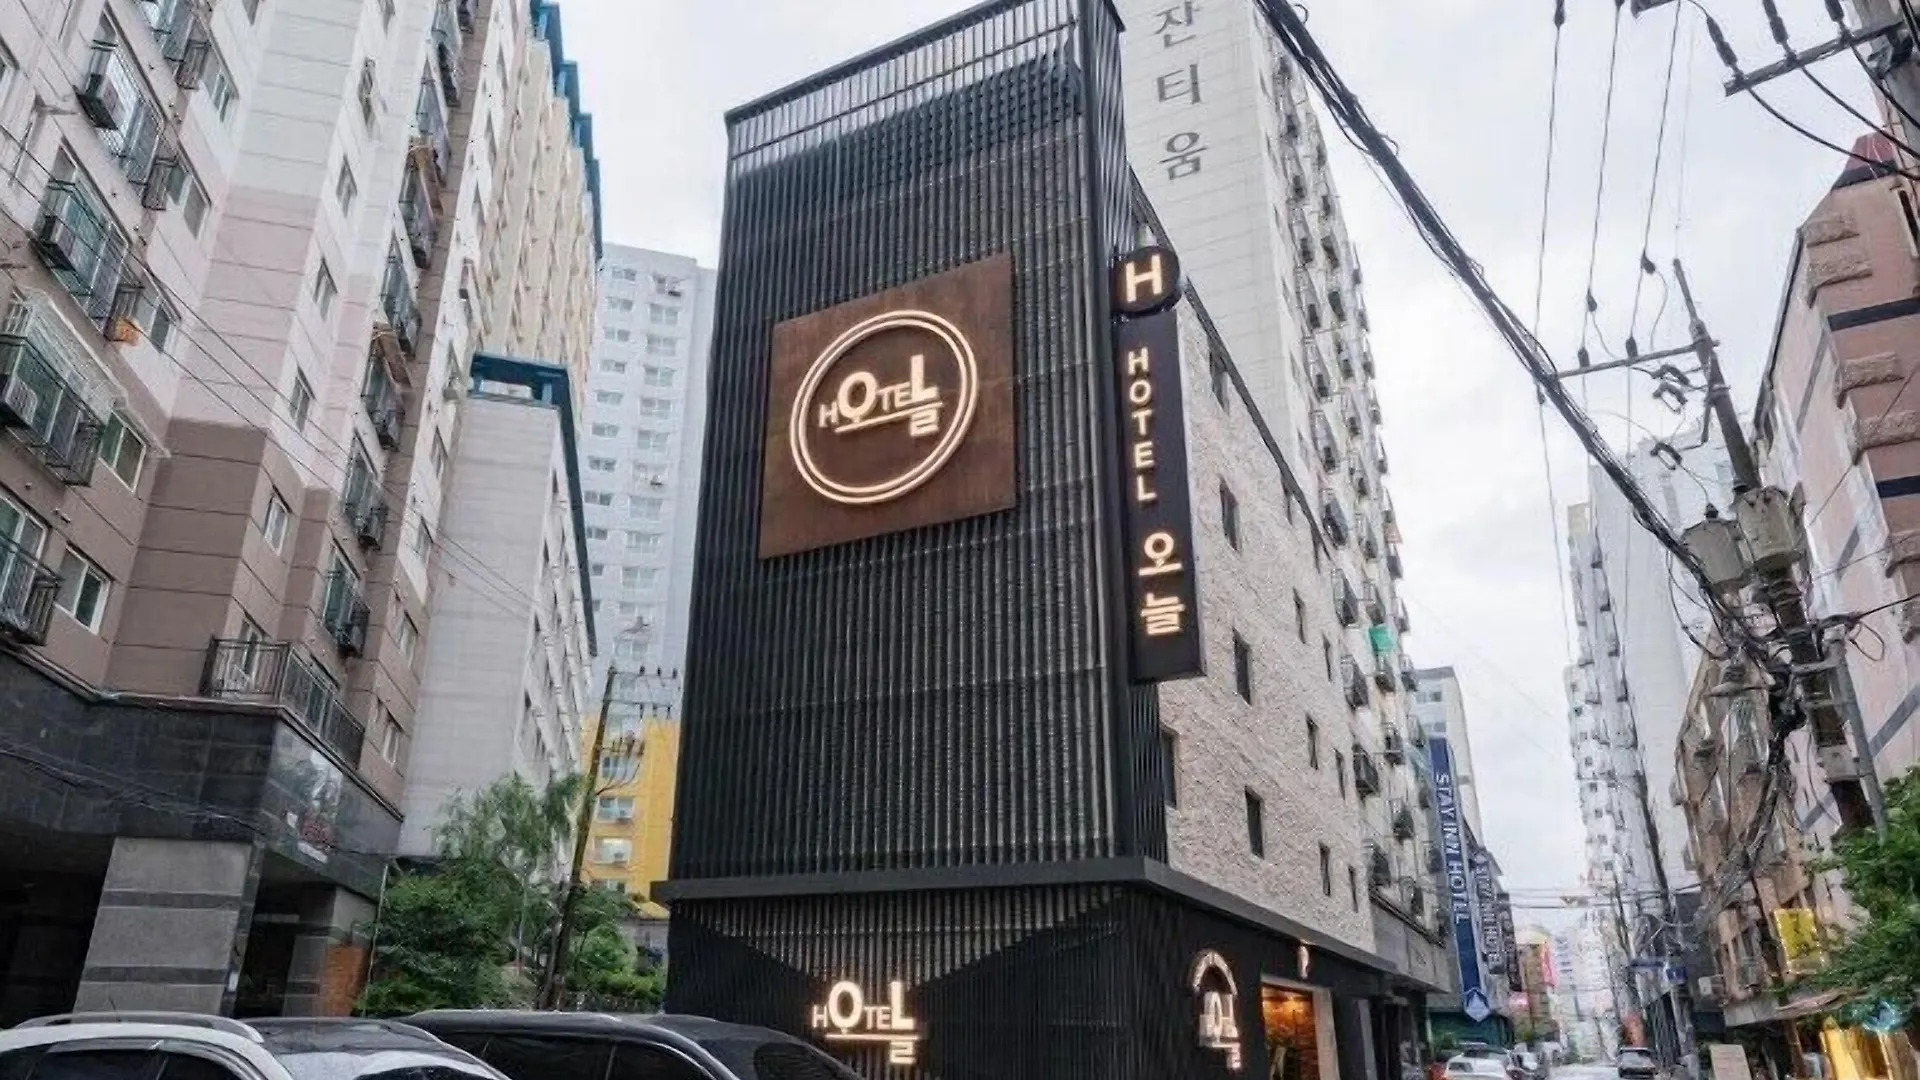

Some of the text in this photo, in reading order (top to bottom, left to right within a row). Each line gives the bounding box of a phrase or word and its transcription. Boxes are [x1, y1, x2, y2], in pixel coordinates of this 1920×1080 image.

[1154, 0, 1209, 181] 잔티움
[1125, 254, 1164, 303] H
[1127, 346, 1158, 503] HOTEL
[1138, 531, 1185, 636] 오늘
